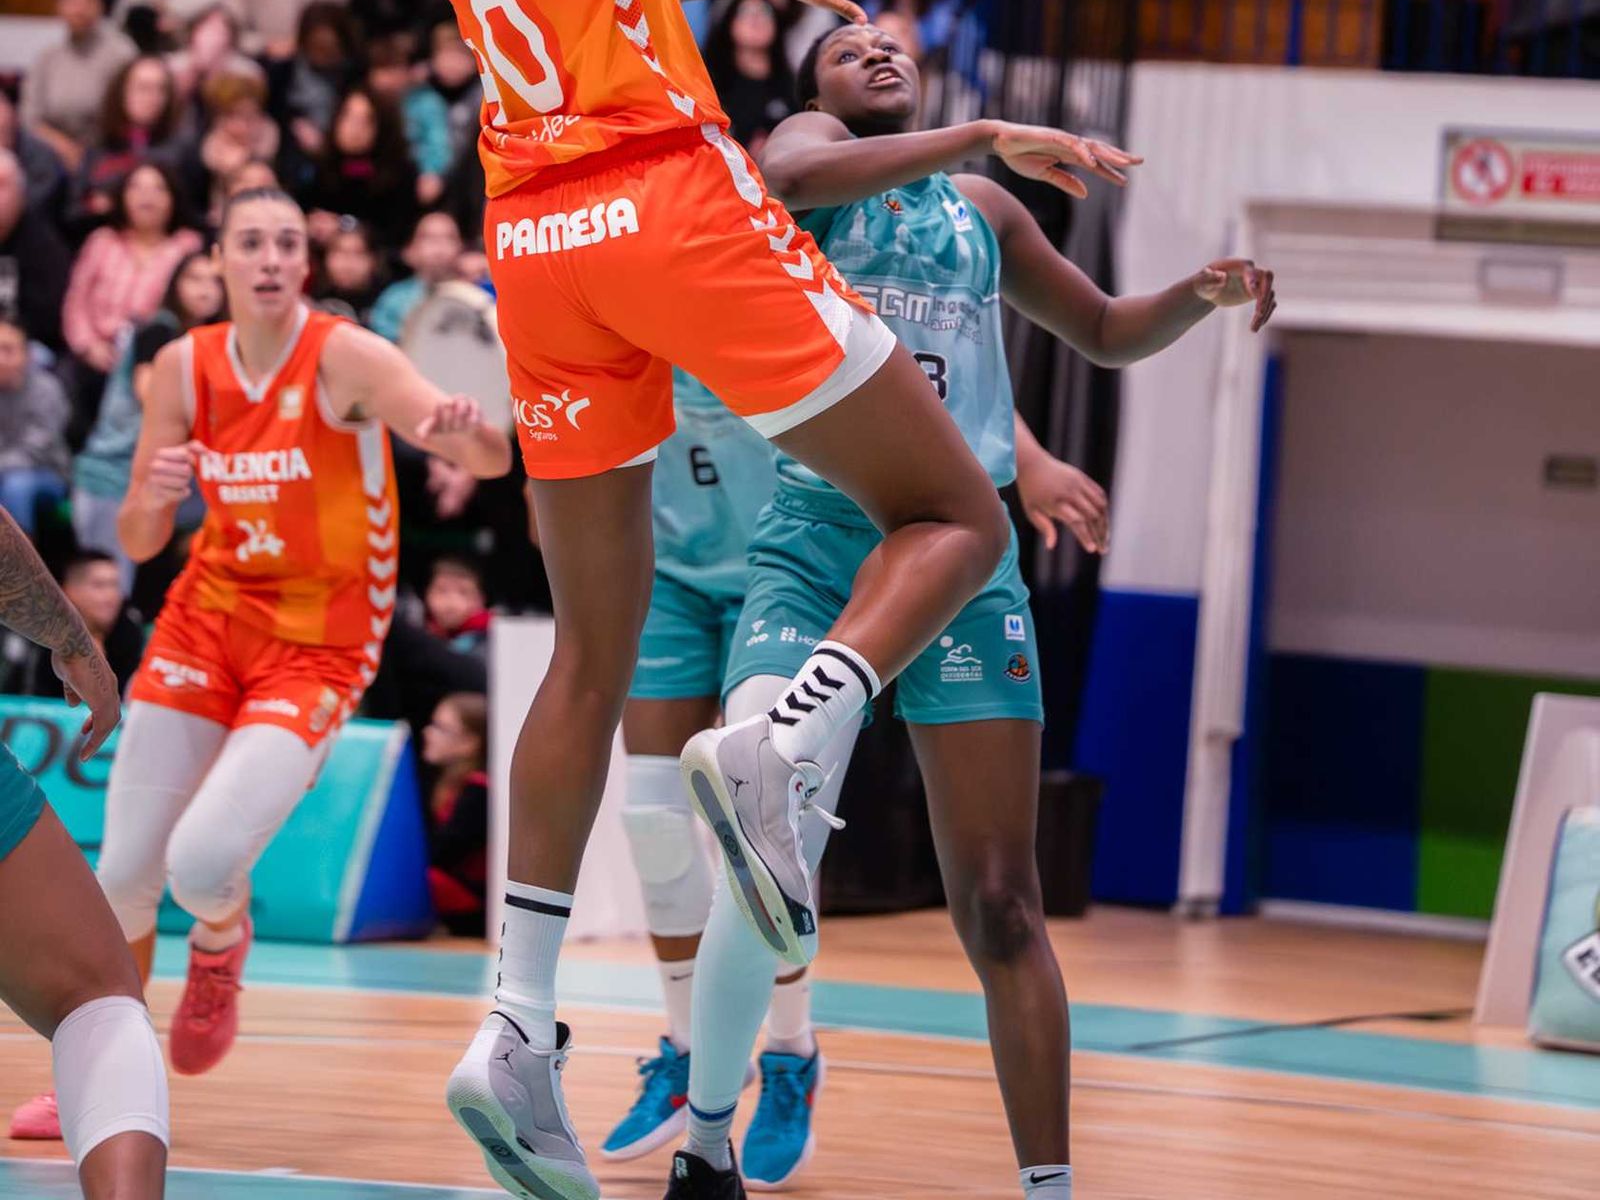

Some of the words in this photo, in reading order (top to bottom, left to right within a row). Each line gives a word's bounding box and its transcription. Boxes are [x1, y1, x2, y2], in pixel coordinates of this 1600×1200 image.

[497, 197, 640, 260] PAMESA
[201, 447, 312, 482] VALENCIA
[690, 445, 720, 486] 6
